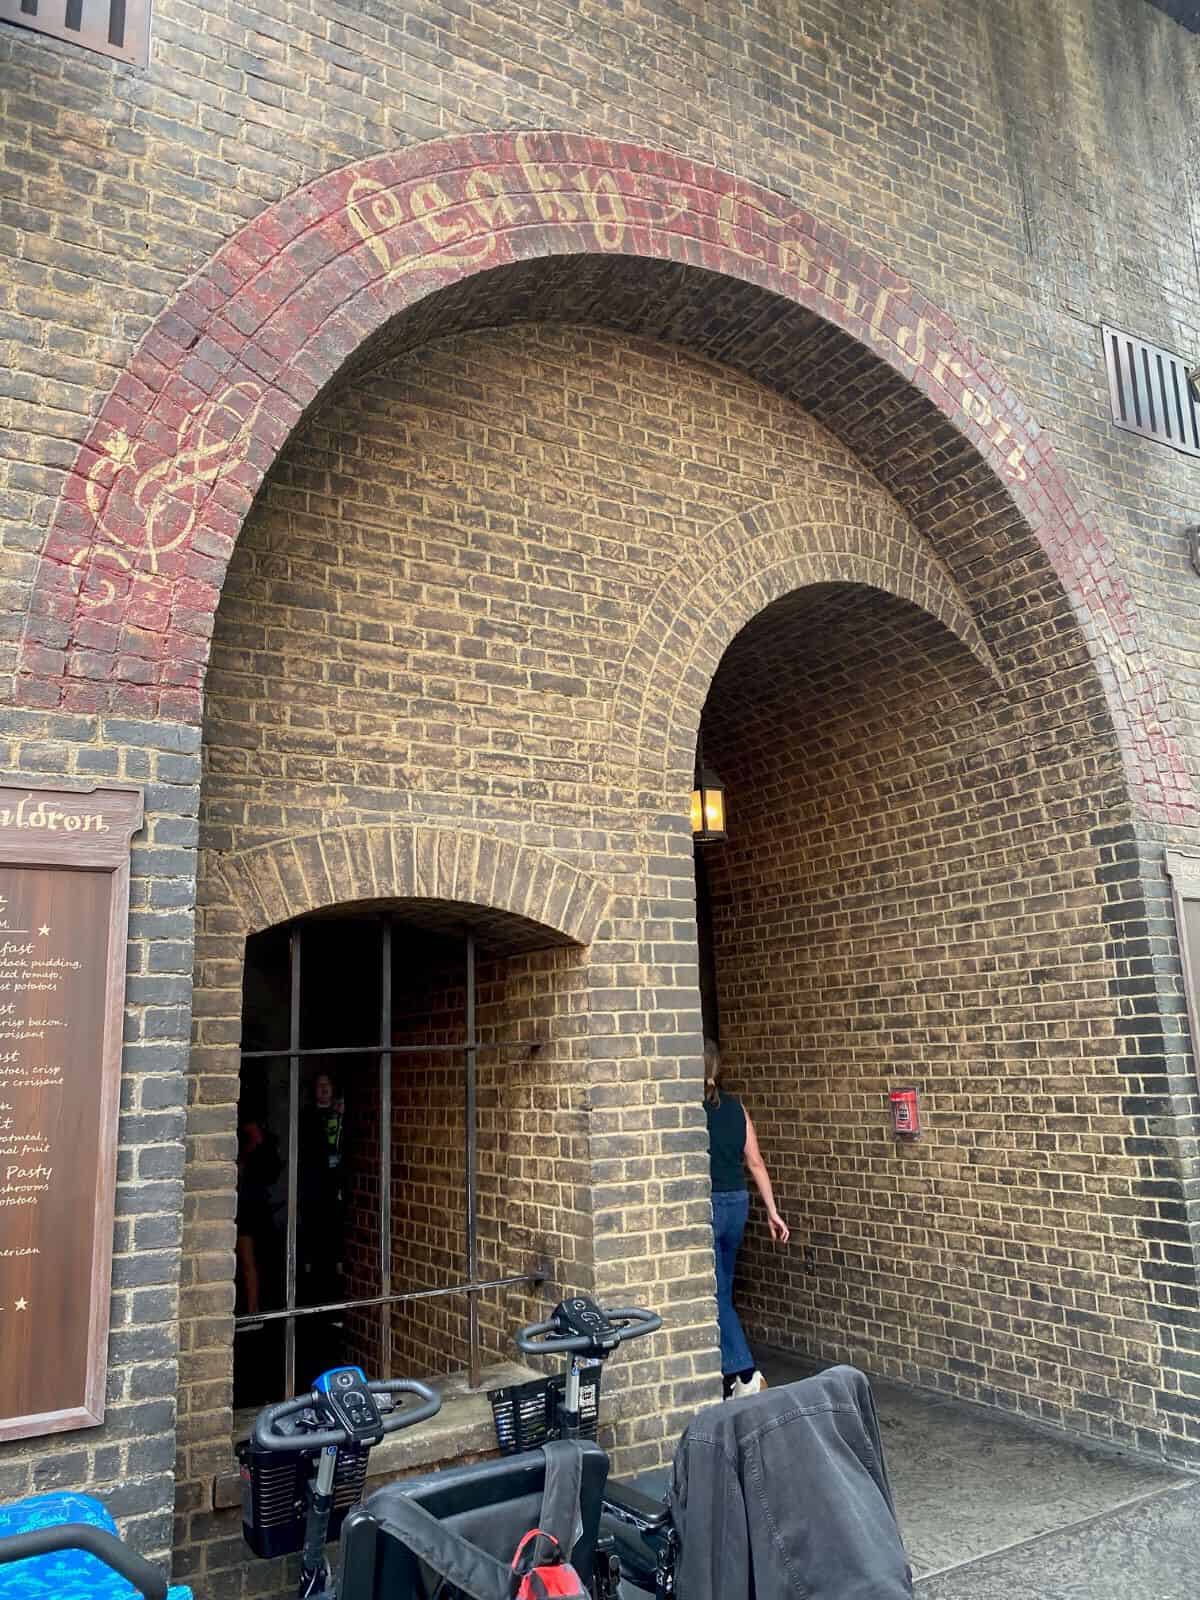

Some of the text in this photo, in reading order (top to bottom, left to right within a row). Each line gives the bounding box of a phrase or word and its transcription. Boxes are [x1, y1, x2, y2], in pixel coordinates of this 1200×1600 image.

[345, 132, 1027, 481] Leaky Cauldron
[14, 981, 57, 992] potatoes
[6, 1163, 52, 1180] Pasty
